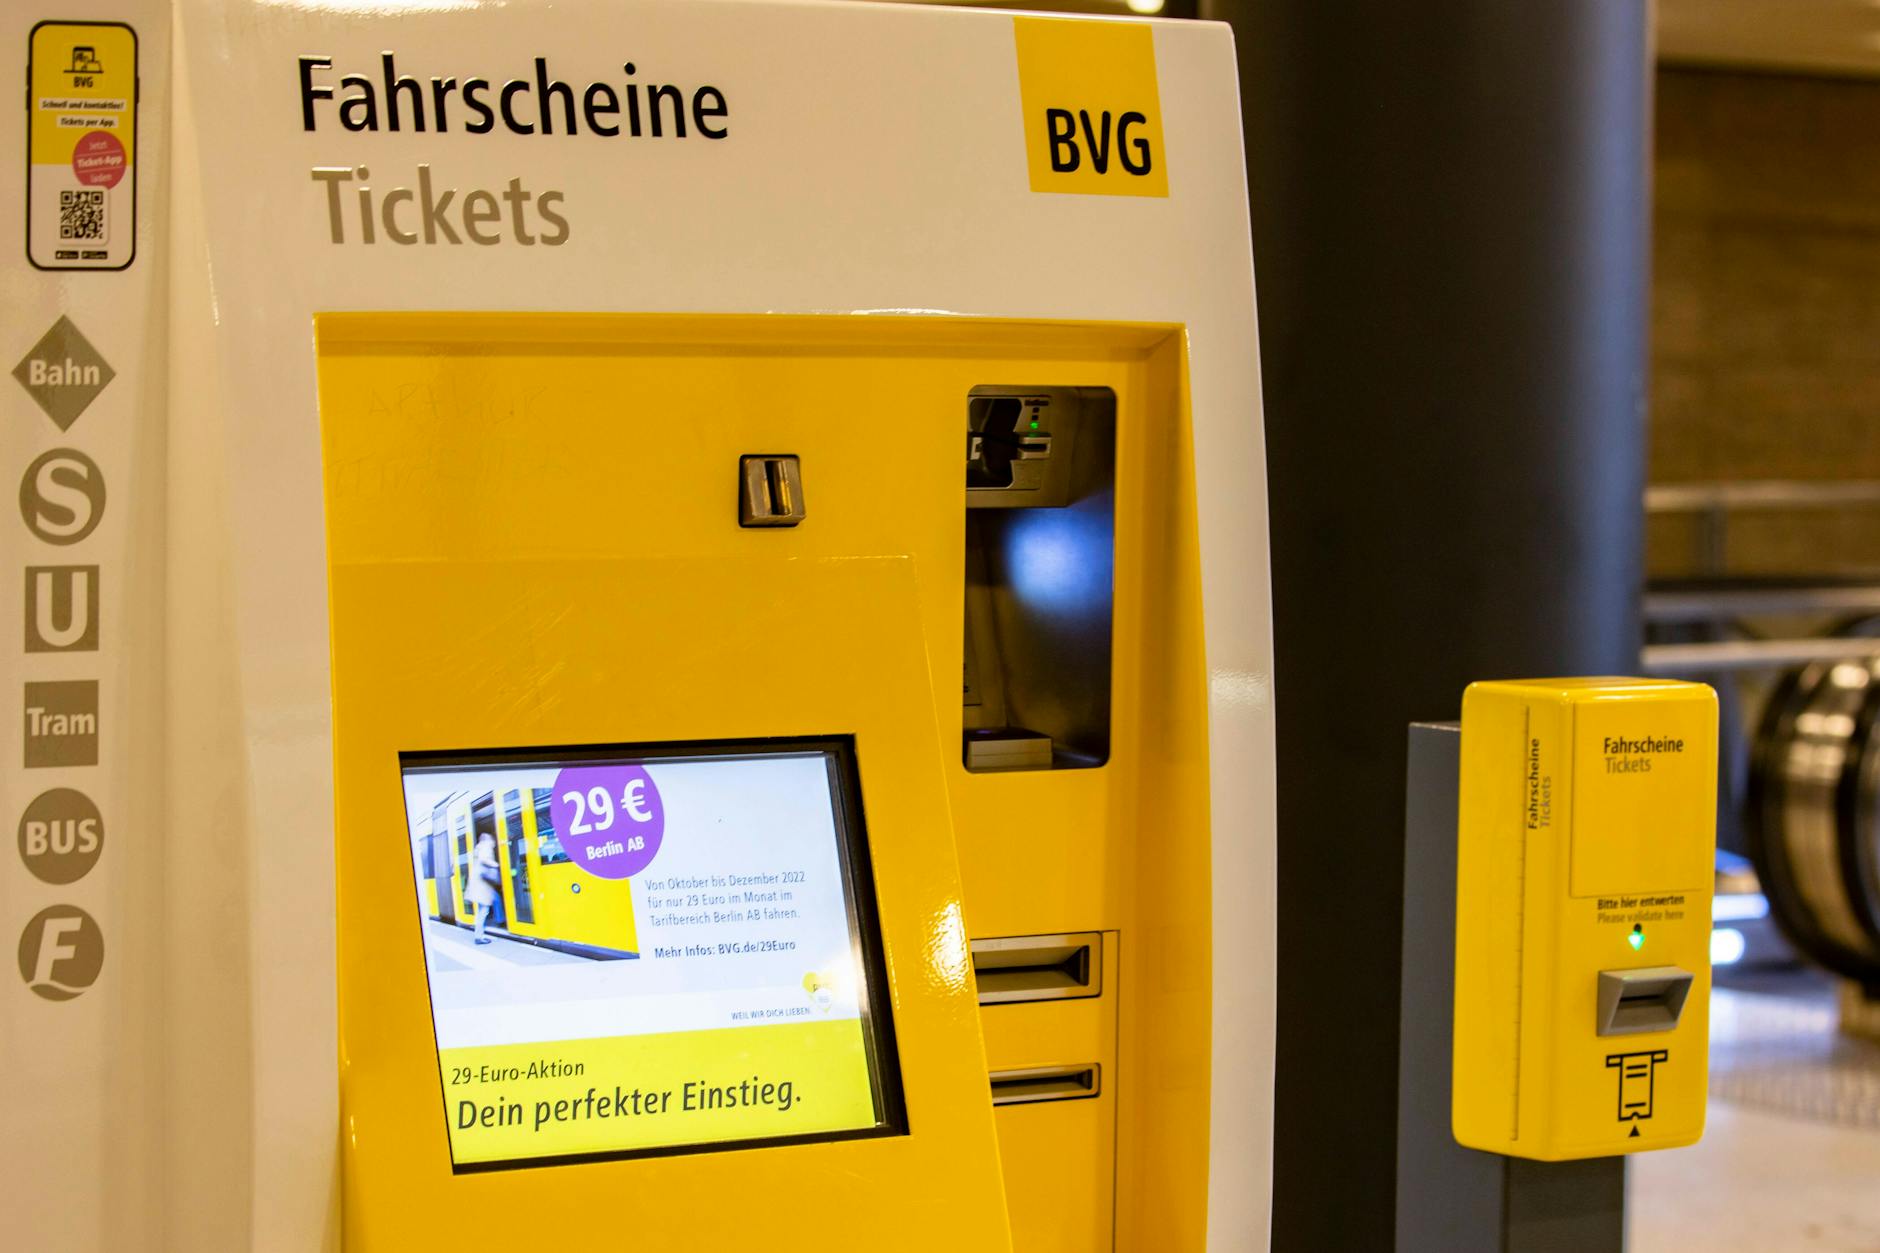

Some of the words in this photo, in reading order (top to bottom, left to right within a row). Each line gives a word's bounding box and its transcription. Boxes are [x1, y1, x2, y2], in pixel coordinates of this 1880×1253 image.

[73, 76, 94, 88] BVG
[298, 50, 728, 139] Fahrscheine
[61, 117, 84, 126] Tickets
[86, 119, 98, 127] per
[1046, 108, 1152, 176] BVG
[311, 163, 570, 246] Tickets
[29, 358, 100, 386] Bahn
[36, 458, 92, 536] S
[36, 571, 88, 647] U
[26, 707, 96, 737] Tram
[1604, 736, 1684, 754] Fahrscheine
[1605, 756, 1651, 774] Tickets
[1528, 738, 1540, 830] Fahrscheine
[562, 786, 615, 836] 29
[620, 779, 653, 822] €
[1540, 775, 1551, 828] Tickets
[26, 818, 98, 856] BUS
[585, 840, 624, 860] Berlin
[628, 836, 645, 852] AB
[645, 879, 665, 891] Von
[668, 876, 709, 890] Oktober
[711, 875, 726, 887] bis
[728, 873, 779, 886] Dezember
[781, 871, 806, 884] 2022
[648, 895, 662, 908] für
[666, 898, 683, 907] nur
[687, 894, 699, 906] 29
[702, 894, 726, 906] Euro
[728, 893, 741, 904] im
[744, 891, 777, 903] Monat
[780, 890, 793, 901] im
[1598, 898, 1618, 910] Bitte
[1621, 896, 1637, 908] hier
[1640, 895, 1685, 907] entwerten
[650, 911, 711, 927] Tarifbereich
[713, 910, 744, 923] Berlin
[747, 908, 761, 920] AB
[764, 907, 800, 920] fahren.
[34, 917, 82, 982] F
[655, 945, 682, 958] Mehr
[685, 944, 716, 957] Infos:
[718, 940, 796, 955] BVG.de/29Euro
[731, 1011, 749, 1020] WEIL
[751, 1010, 765, 1019] WIR
[766, 1008, 784, 1018] DICH
[452, 1059, 584, 1085] 29-Euro-Aktion
[458, 1096, 523, 1129] Dein
[535, 1086, 672, 1132] perfekter
[683, 1076, 801, 1112] Einstieg.
